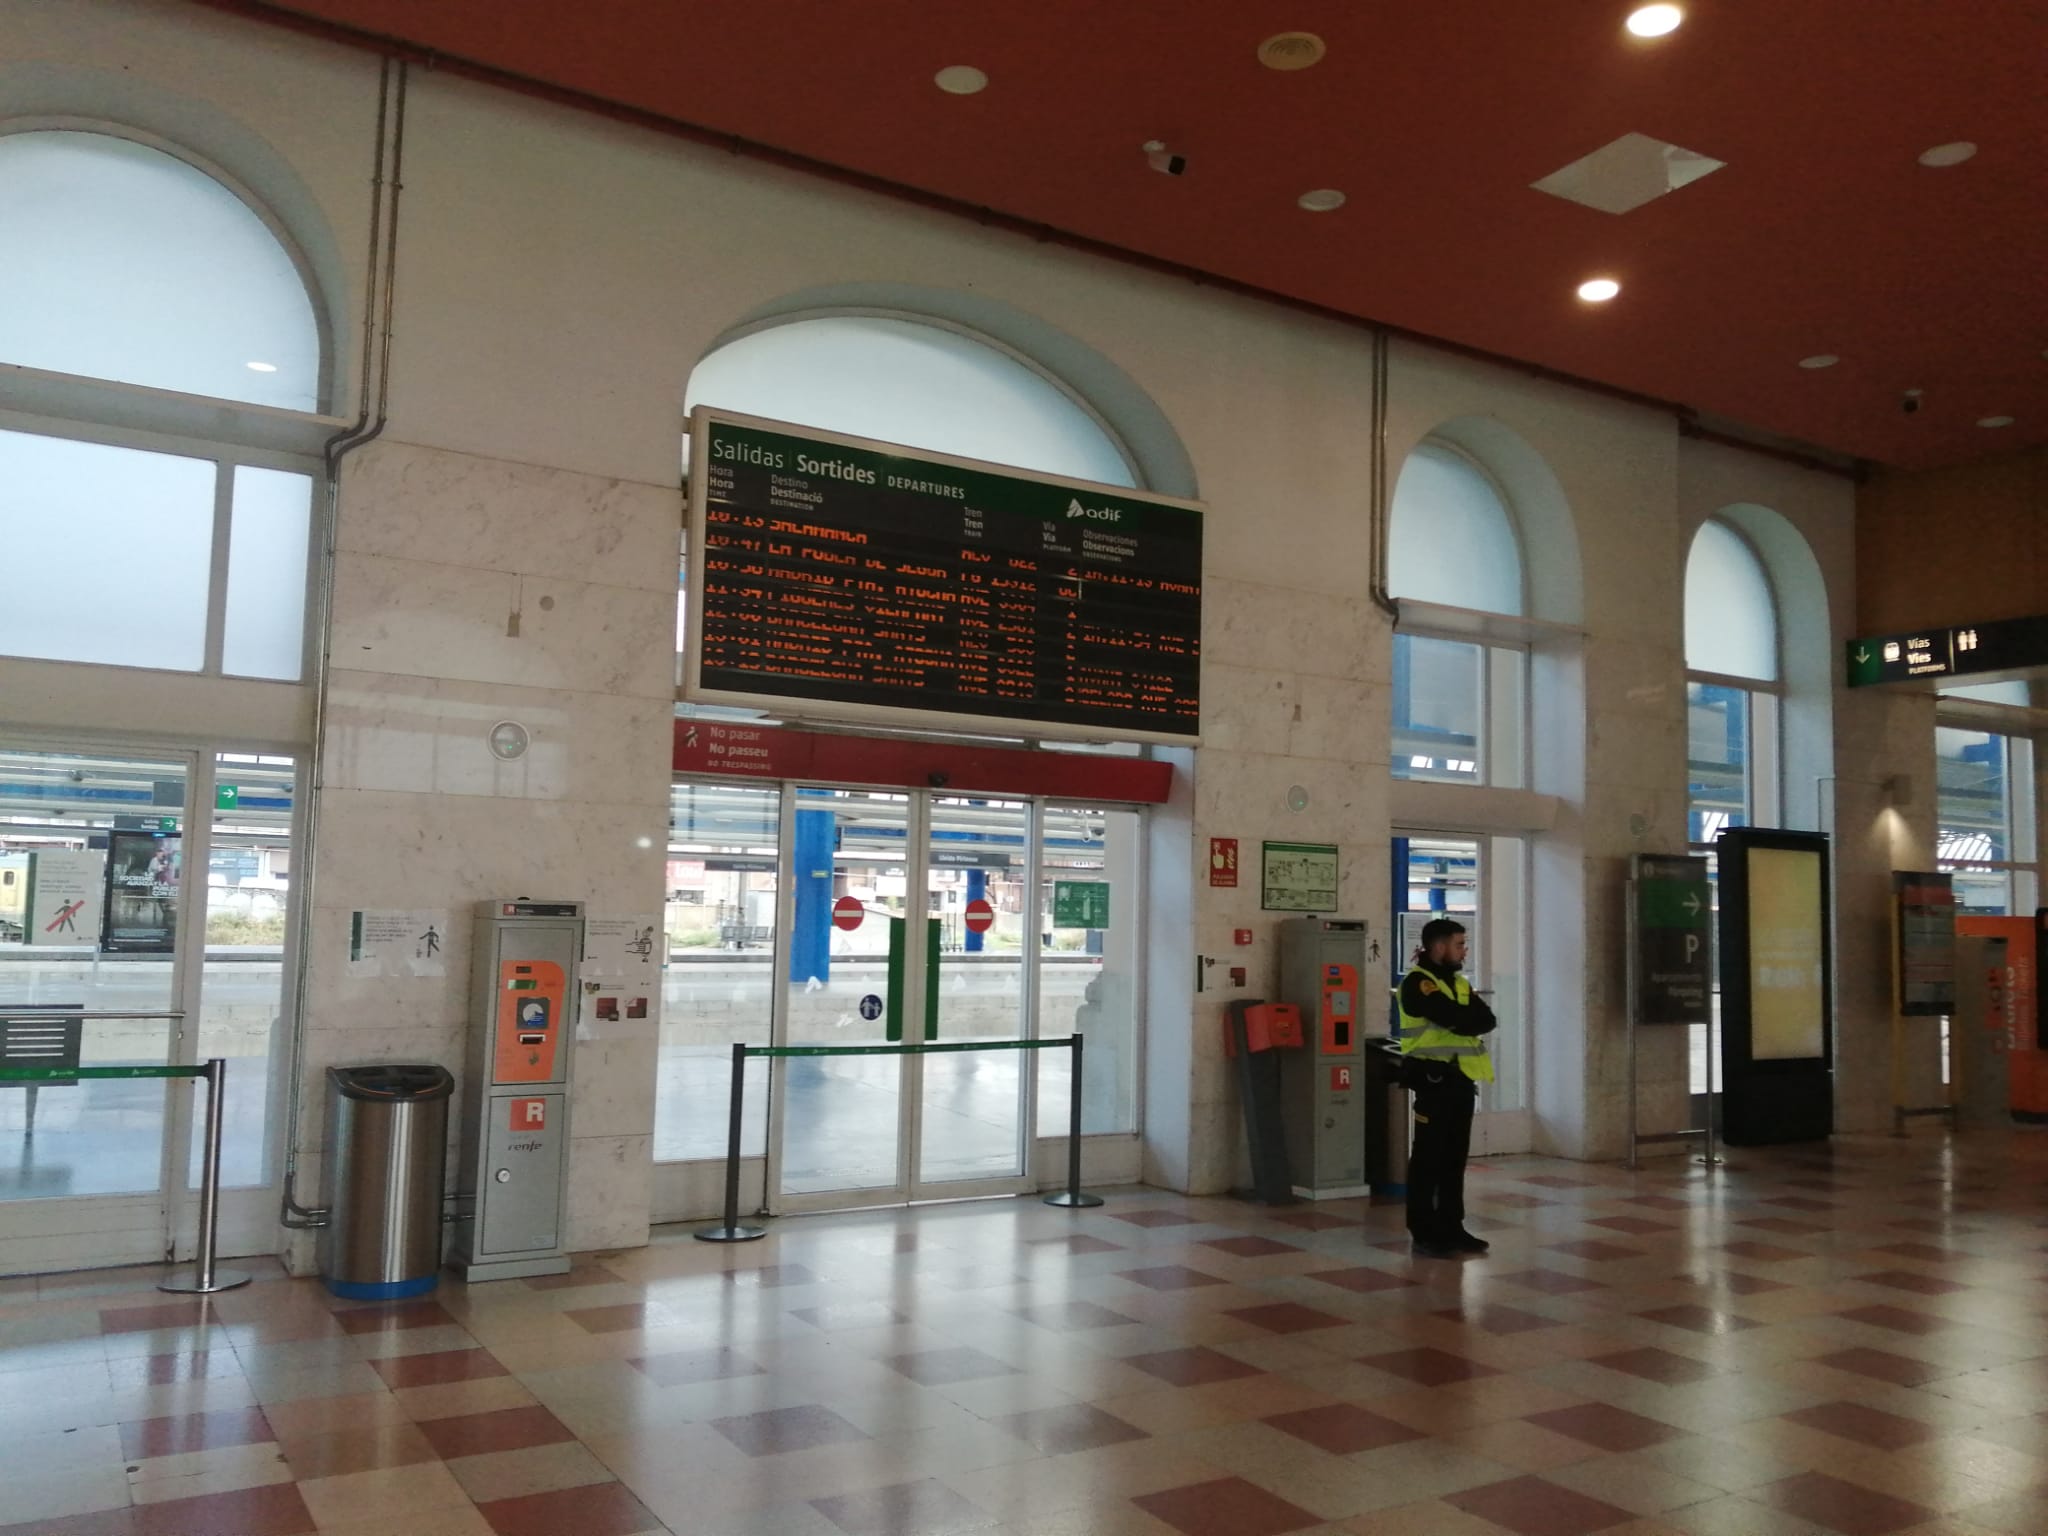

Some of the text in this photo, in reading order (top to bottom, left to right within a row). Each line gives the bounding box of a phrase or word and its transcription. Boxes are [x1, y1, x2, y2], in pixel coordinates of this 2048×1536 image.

[709, 465, 734, 478] Hora
[713, 439, 965, 500] Salidas Sortides DEPARTURES
[709, 476, 734, 490] Hora
[771, 474, 808, 490] Destino
[771, 486, 823, 504] Destinació
[964, 507, 983, 518] Tren
[1086, 506, 1122, 522] adif
[964, 517, 983, 529] Tren
[1083, 529, 1138, 548] Observaciones
[1083, 540, 1135, 557] Observacions
[1907, 652, 1932, 665] Vies
[710, 727, 761, 742] No pasar
[709, 743, 769, 758] No passeu
[1686, 934, 1700, 963] P
[1340, 1069, 1350, 1085] R
[526, 1102, 544, 1122] R
[508, 1140, 542, 1152] renfe
